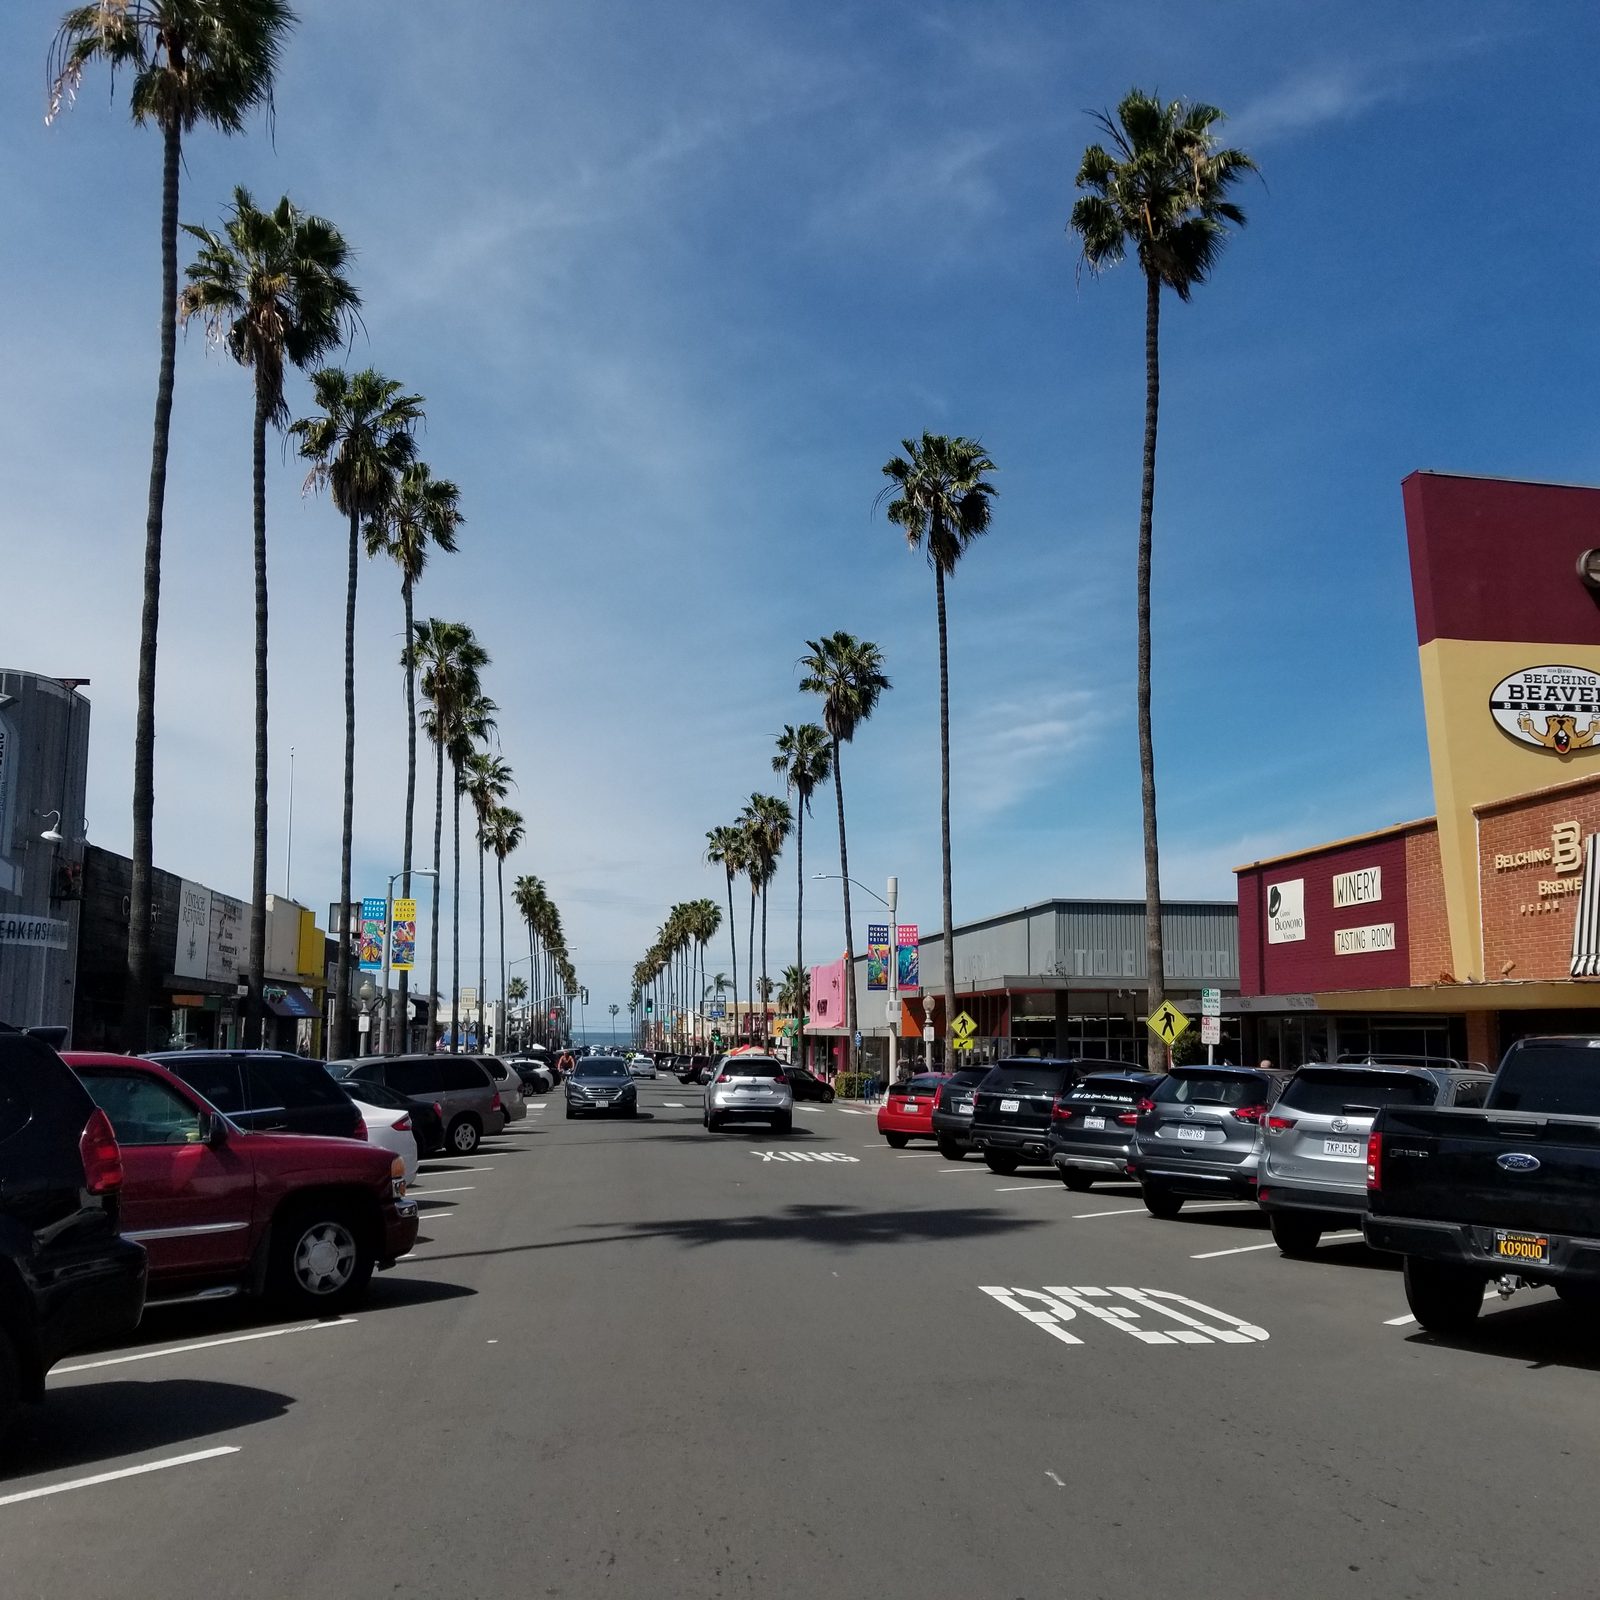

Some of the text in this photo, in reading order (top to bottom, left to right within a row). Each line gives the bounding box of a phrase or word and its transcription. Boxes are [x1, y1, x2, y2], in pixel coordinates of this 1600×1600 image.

[1523, 673, 1597, 686] BELCHING
[1508, 684, 1600, 702] BEAVE
[1495, 847, 1552, 869] BELCHING
[1336, 870, 1377, 904] WINERY
[1337, 927, 1393, 951] TASTING ROOM
[1203, 989, 1210, 997] 2
[1326, 1142, 1358, 1154] 7KPJ156
[750, 1151, 860, 1162] XING
[1507, 1235, 1537, 1243] CALIFORNIA
[978, 1286, 1270, 1344] PED
